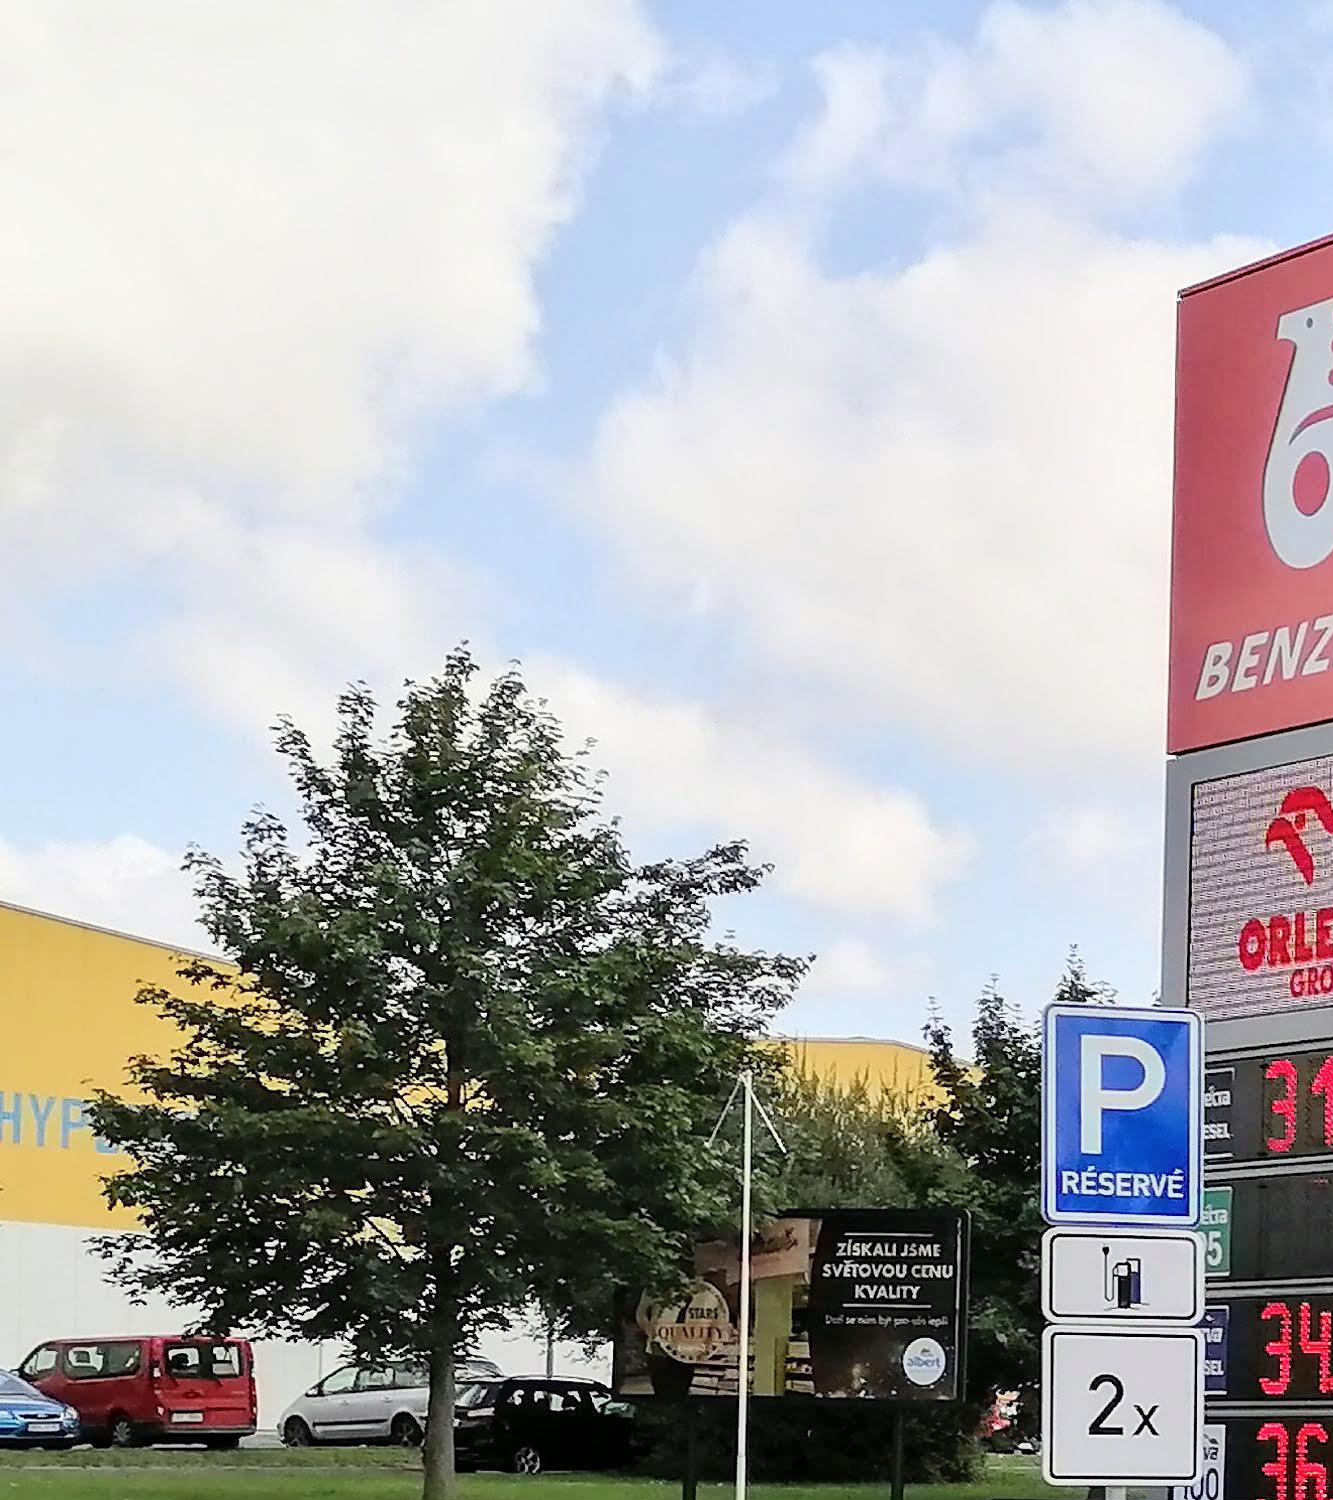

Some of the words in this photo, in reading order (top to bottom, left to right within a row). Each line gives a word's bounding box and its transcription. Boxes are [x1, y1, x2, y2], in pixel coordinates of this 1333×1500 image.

[1081, 1034, 1166, 1155] P
[1062, 1166, 1184, 1198] RÉSERVÉ
[836, 1240, 897, 1257] ZÍSKALI
[900, 1243, 941, 1257] JSME
[822, 1260, 908, 1278] SVĚTOVOU
[911, 1264, 954, 1279] CENU
[854, 1284, 921, 1299] KVALITY
[659, 1326, 722, 1339] QUALITY
